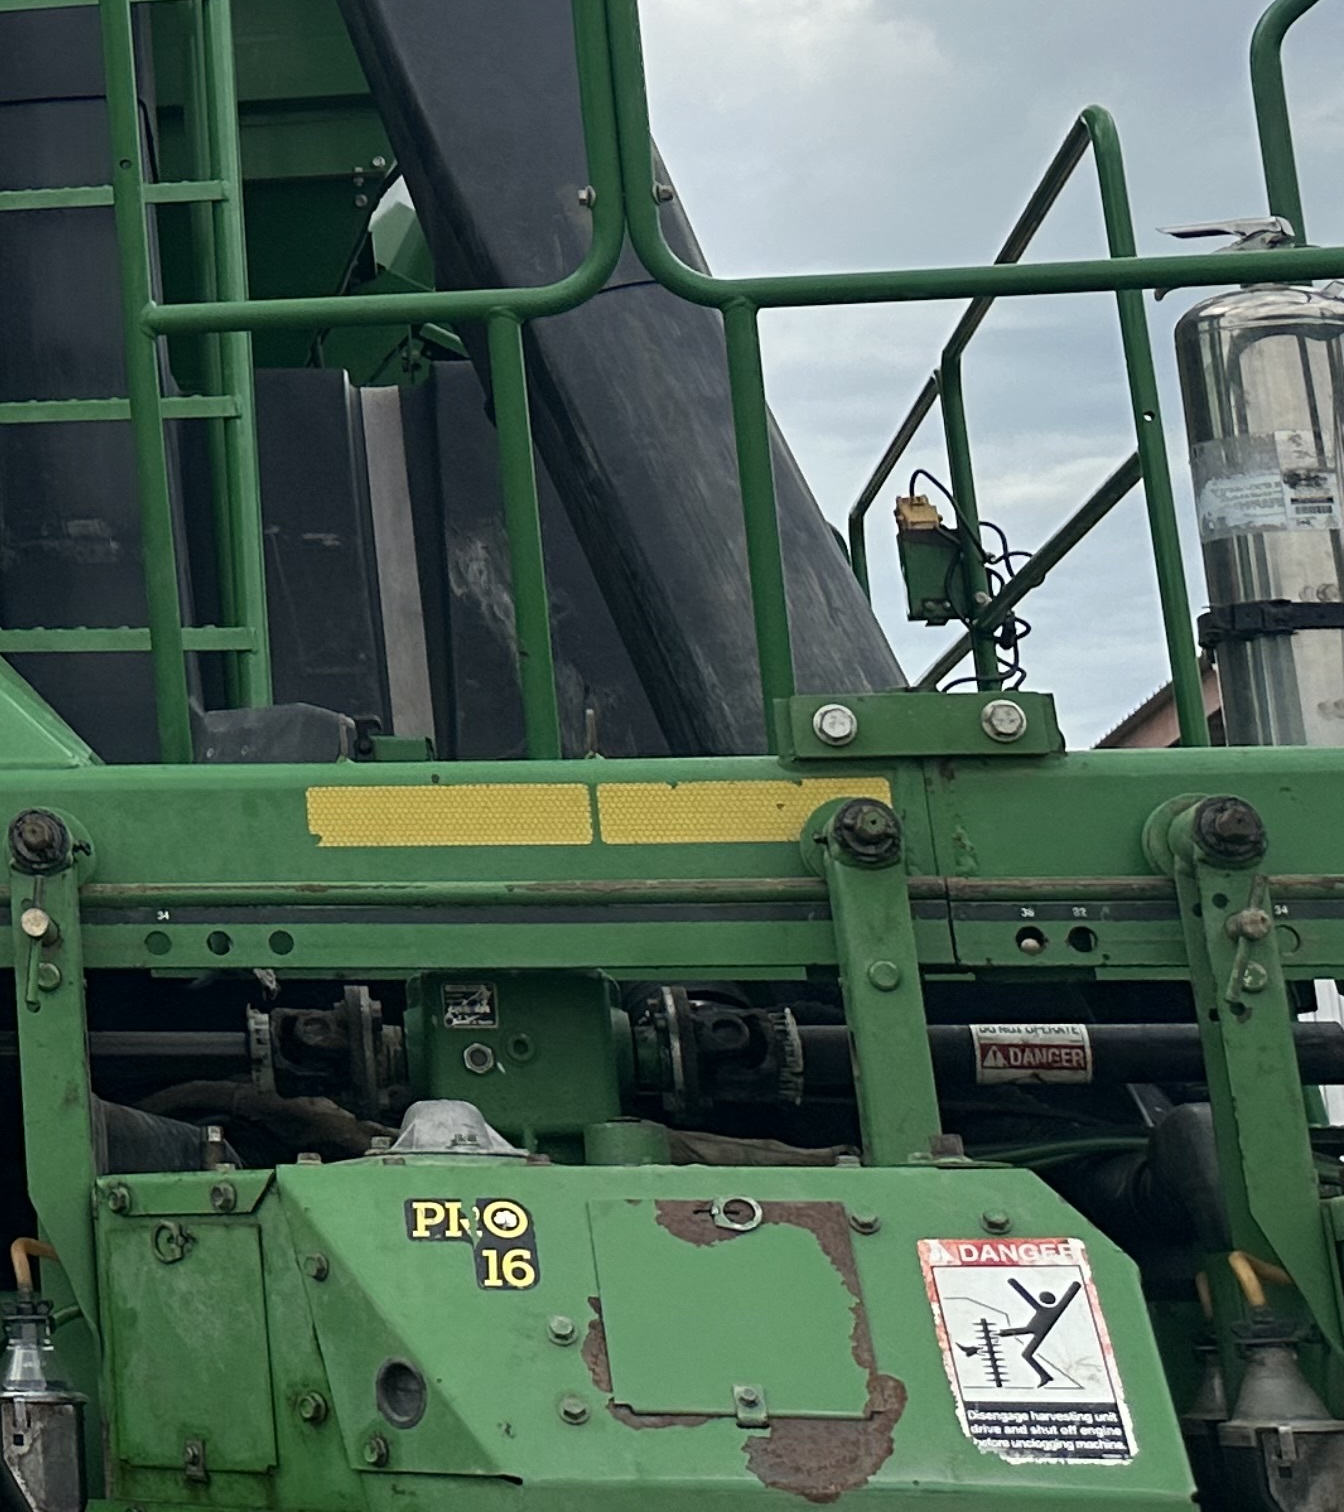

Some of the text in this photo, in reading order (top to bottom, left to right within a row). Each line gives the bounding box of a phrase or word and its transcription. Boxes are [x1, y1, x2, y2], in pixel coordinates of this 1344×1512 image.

[1009, 1047, 1086, 1068] DANGER
[481, 1248, 535, 1287] 16
[966, 1409, 1118, 1424] Disengage harvesting unit
[970, 1423, 1123, 1437] drive and shut off engine
[1013, 1438, 1075, 1451] unclogging
